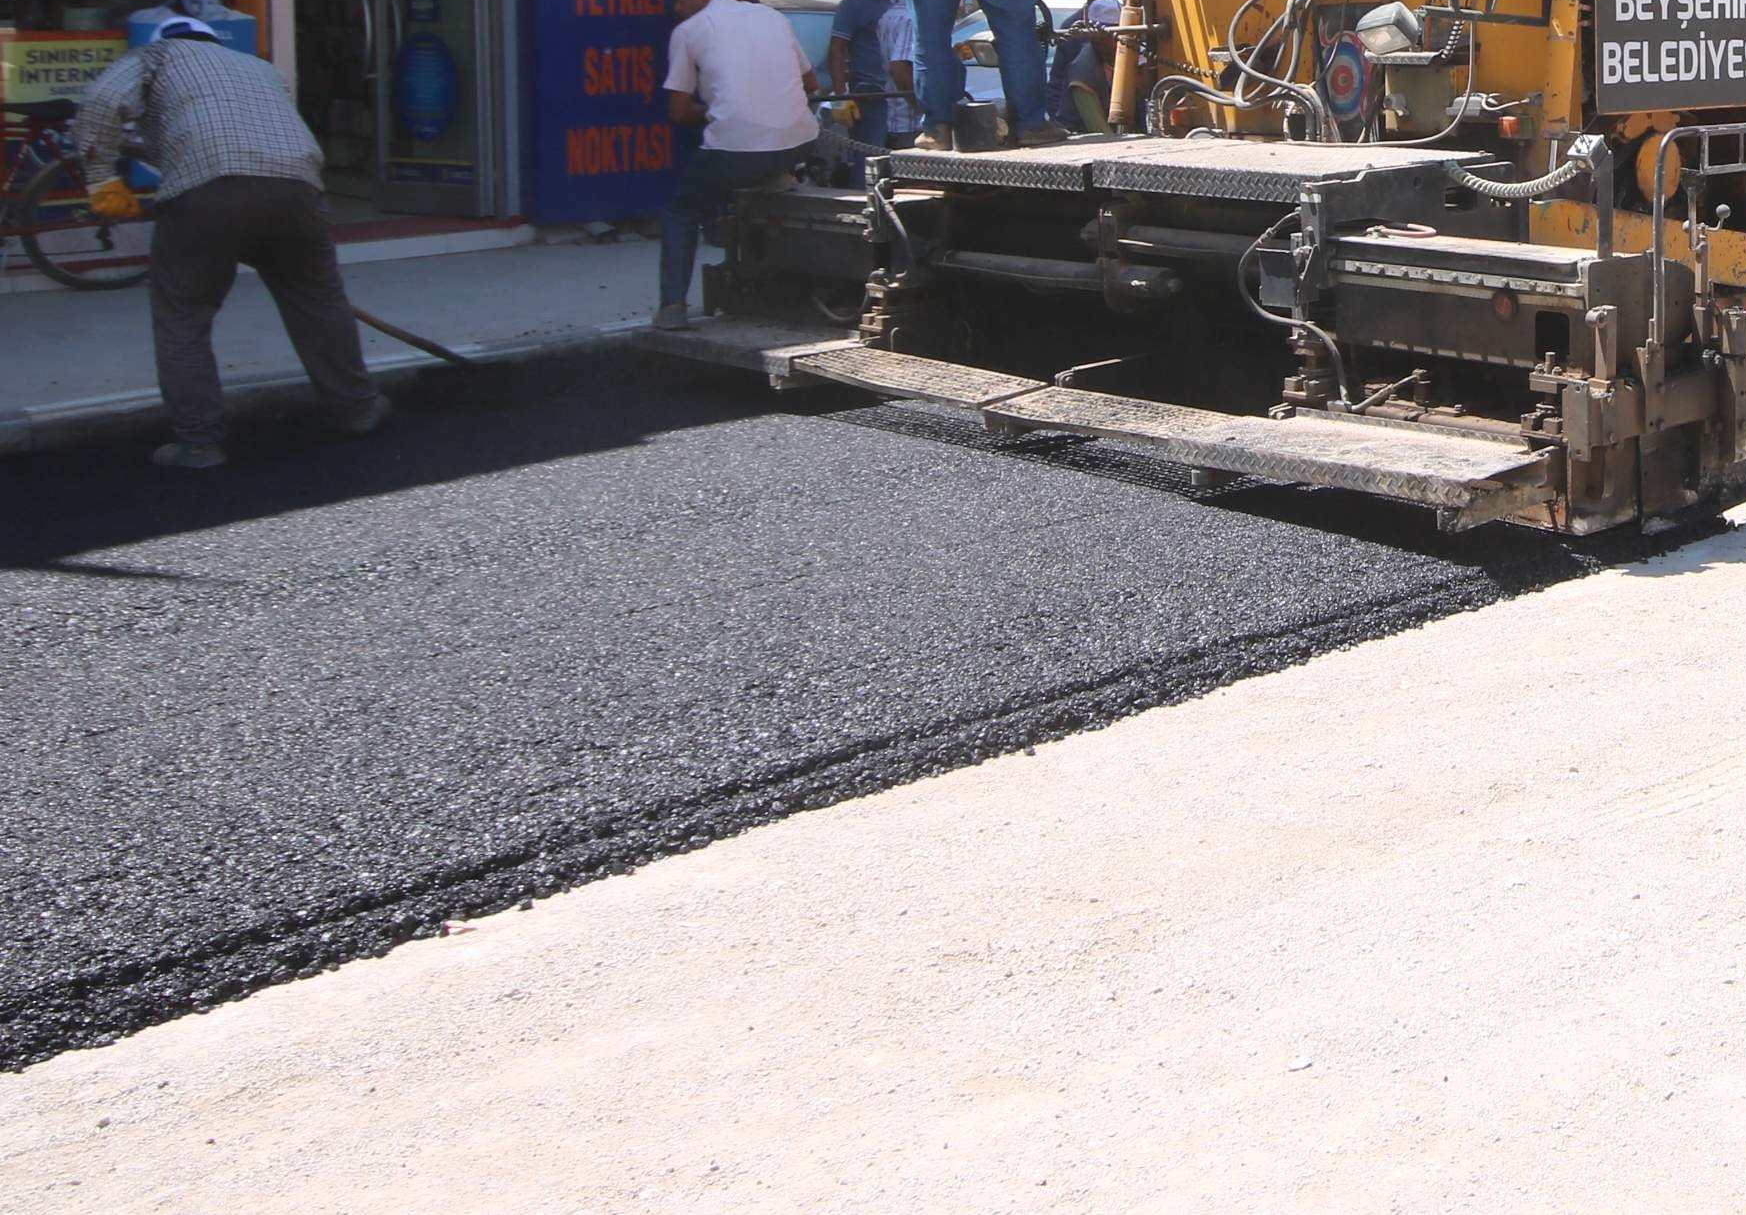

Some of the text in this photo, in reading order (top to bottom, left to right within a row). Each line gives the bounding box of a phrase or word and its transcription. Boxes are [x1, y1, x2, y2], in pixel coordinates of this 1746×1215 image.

[18, 64, 106, 84] İNTERN
[25, 47, 115, 66] SINIRSIZ
[583, 45, 657, 106] SATIŞ
[566, 123, 674, 176] NOKTASI
